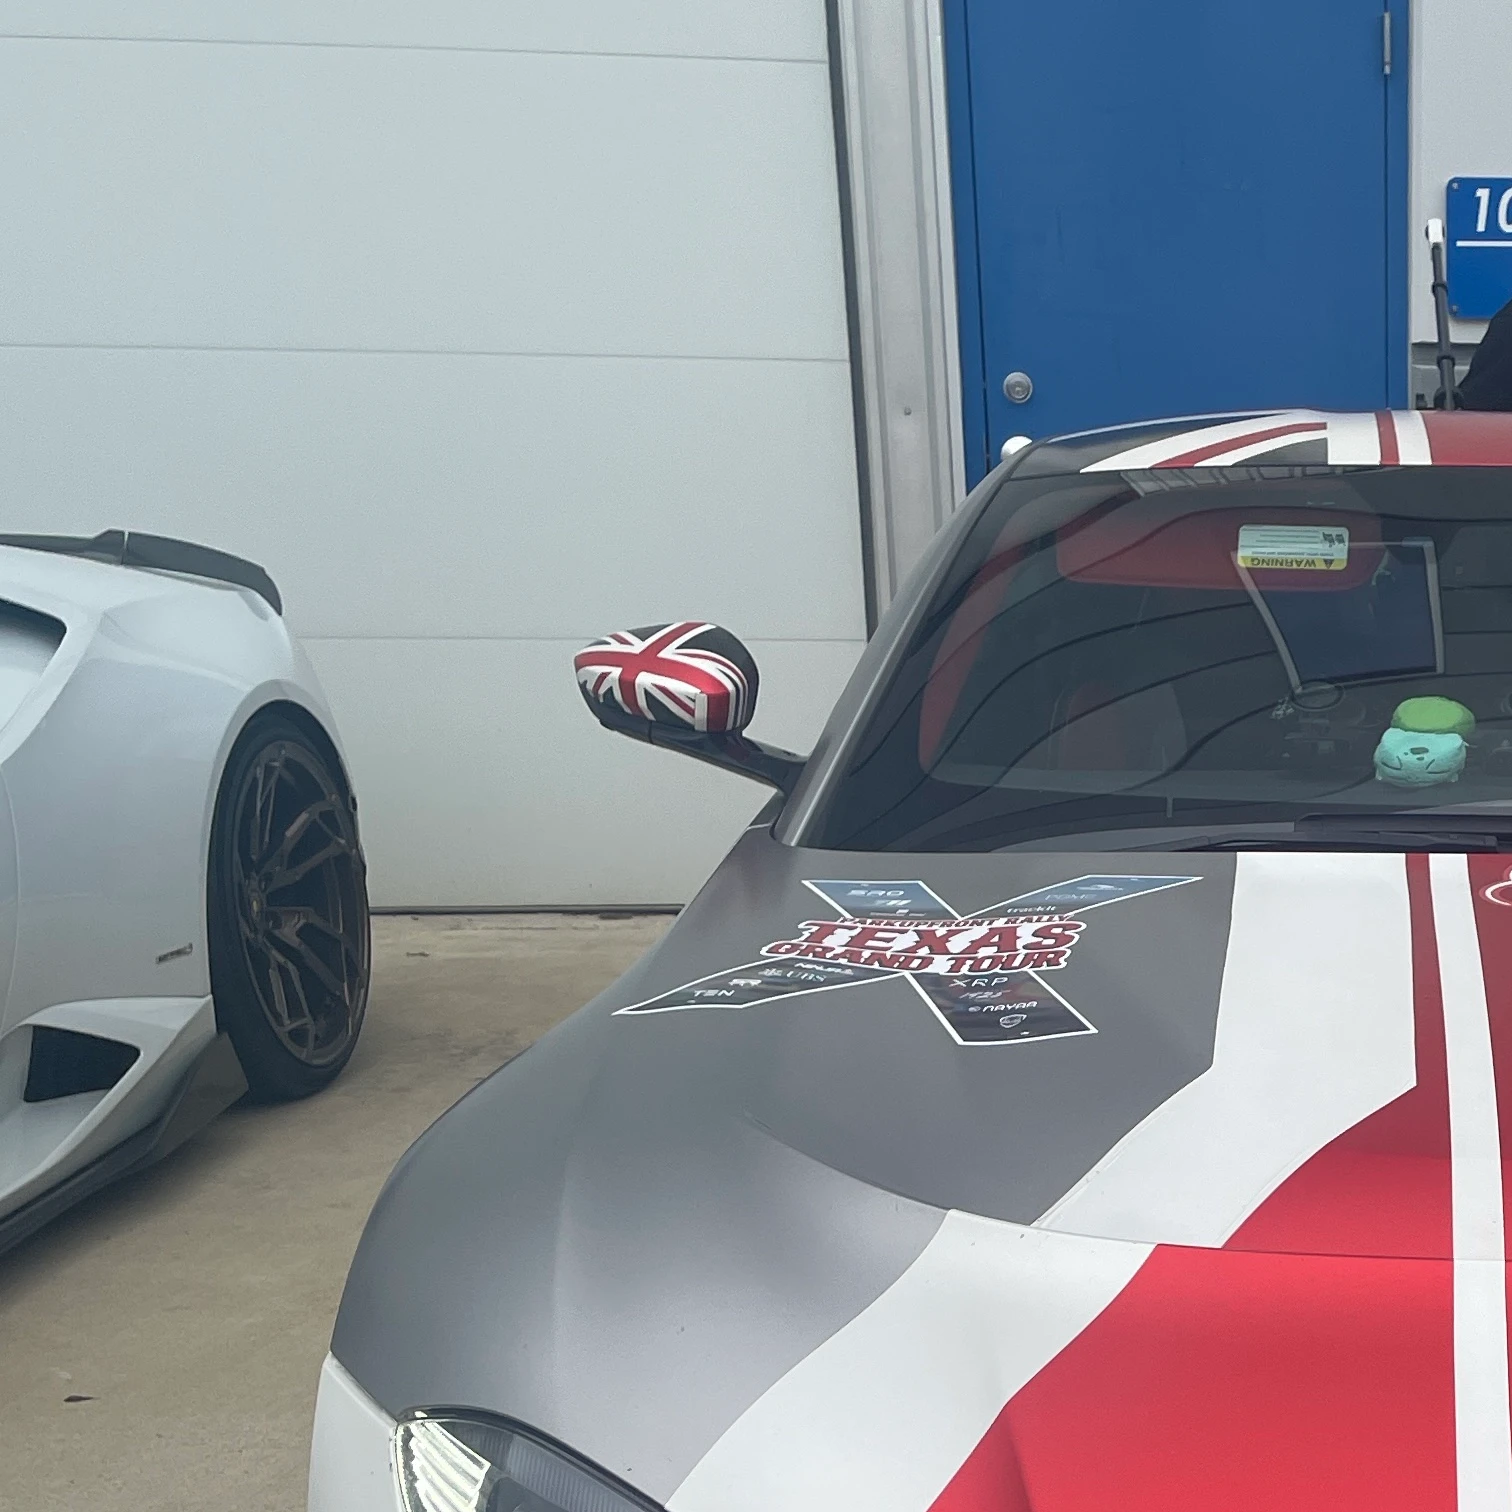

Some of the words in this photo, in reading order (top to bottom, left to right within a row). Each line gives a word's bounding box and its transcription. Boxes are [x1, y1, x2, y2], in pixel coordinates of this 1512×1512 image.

[1250, 557, 1317, 568] WARNING
[1003, 914, 1073, 925] RALLY
[799, 921, 1083, 955] TEXAS
[764, 942, 934, 971] GRAND
[947, 950, 1067, 974] TOUR
[949, 977, 1008, 987] XRP
